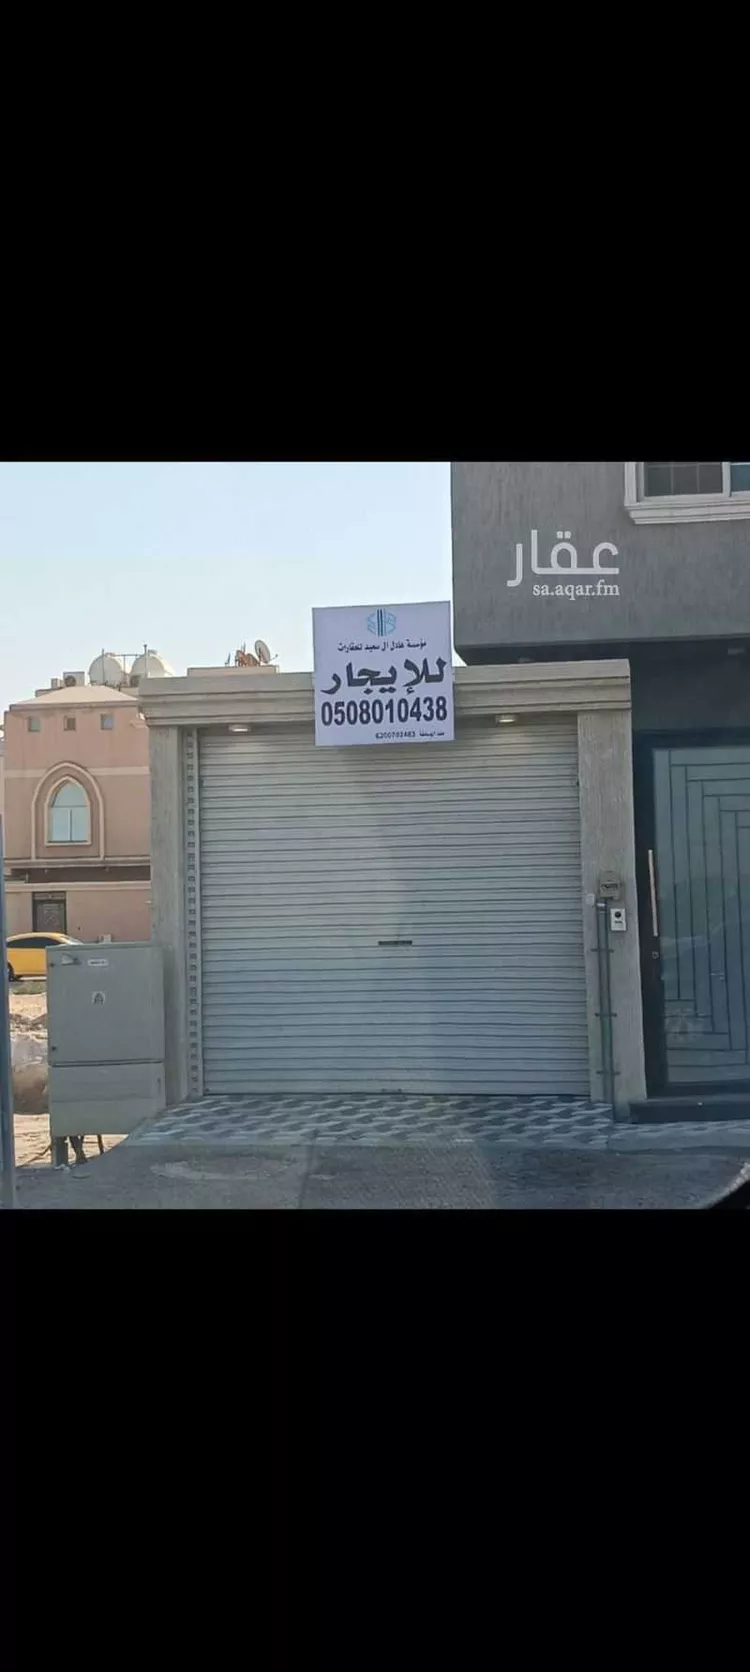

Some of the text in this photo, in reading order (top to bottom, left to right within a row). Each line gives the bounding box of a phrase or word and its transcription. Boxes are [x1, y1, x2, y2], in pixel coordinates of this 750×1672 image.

[364, 644, 380, 653] سعيد
[406, 638, 427, 650] مؤسسة
[320, 656, 447, 695] للإيجار
[321, 696, 448, 726] 0508010438
